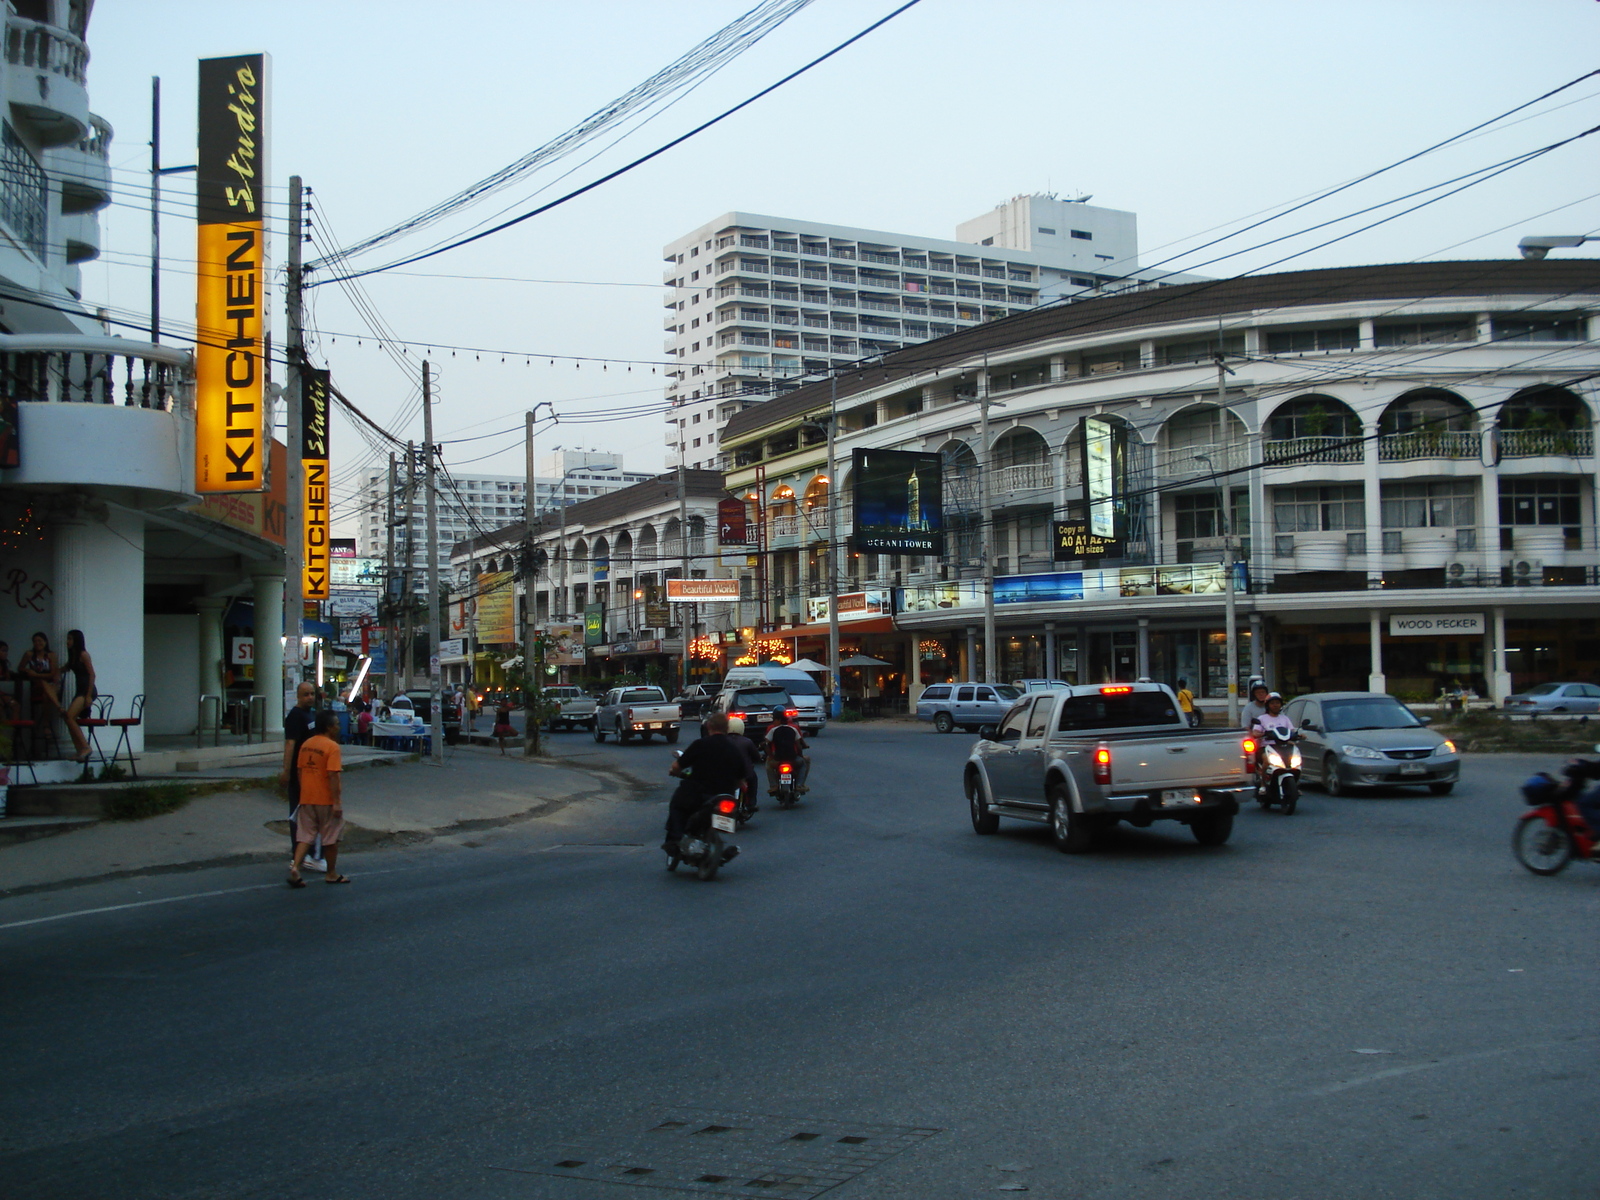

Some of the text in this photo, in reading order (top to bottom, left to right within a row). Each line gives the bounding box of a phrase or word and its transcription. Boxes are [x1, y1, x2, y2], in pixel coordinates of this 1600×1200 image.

[225, 62, 256, 214] Studio
[225, 230, 255, 482] KITCHEN
[308, 464, 325, 595] KITCHEN
[1058, 525, 1076, 536] Copy
[867, 538, 897, 547] OCEAN
[903, 540, 932, 549] TOWER
[1061, 535, 1074, 548] A0
[1075, 534, 1087, 546] A1
[1074, 544, 1105, 555] All sizes
[682, 584, 736, 595] Beautiful World
[1397, 618, 1478, 629] WOOD PECKER
